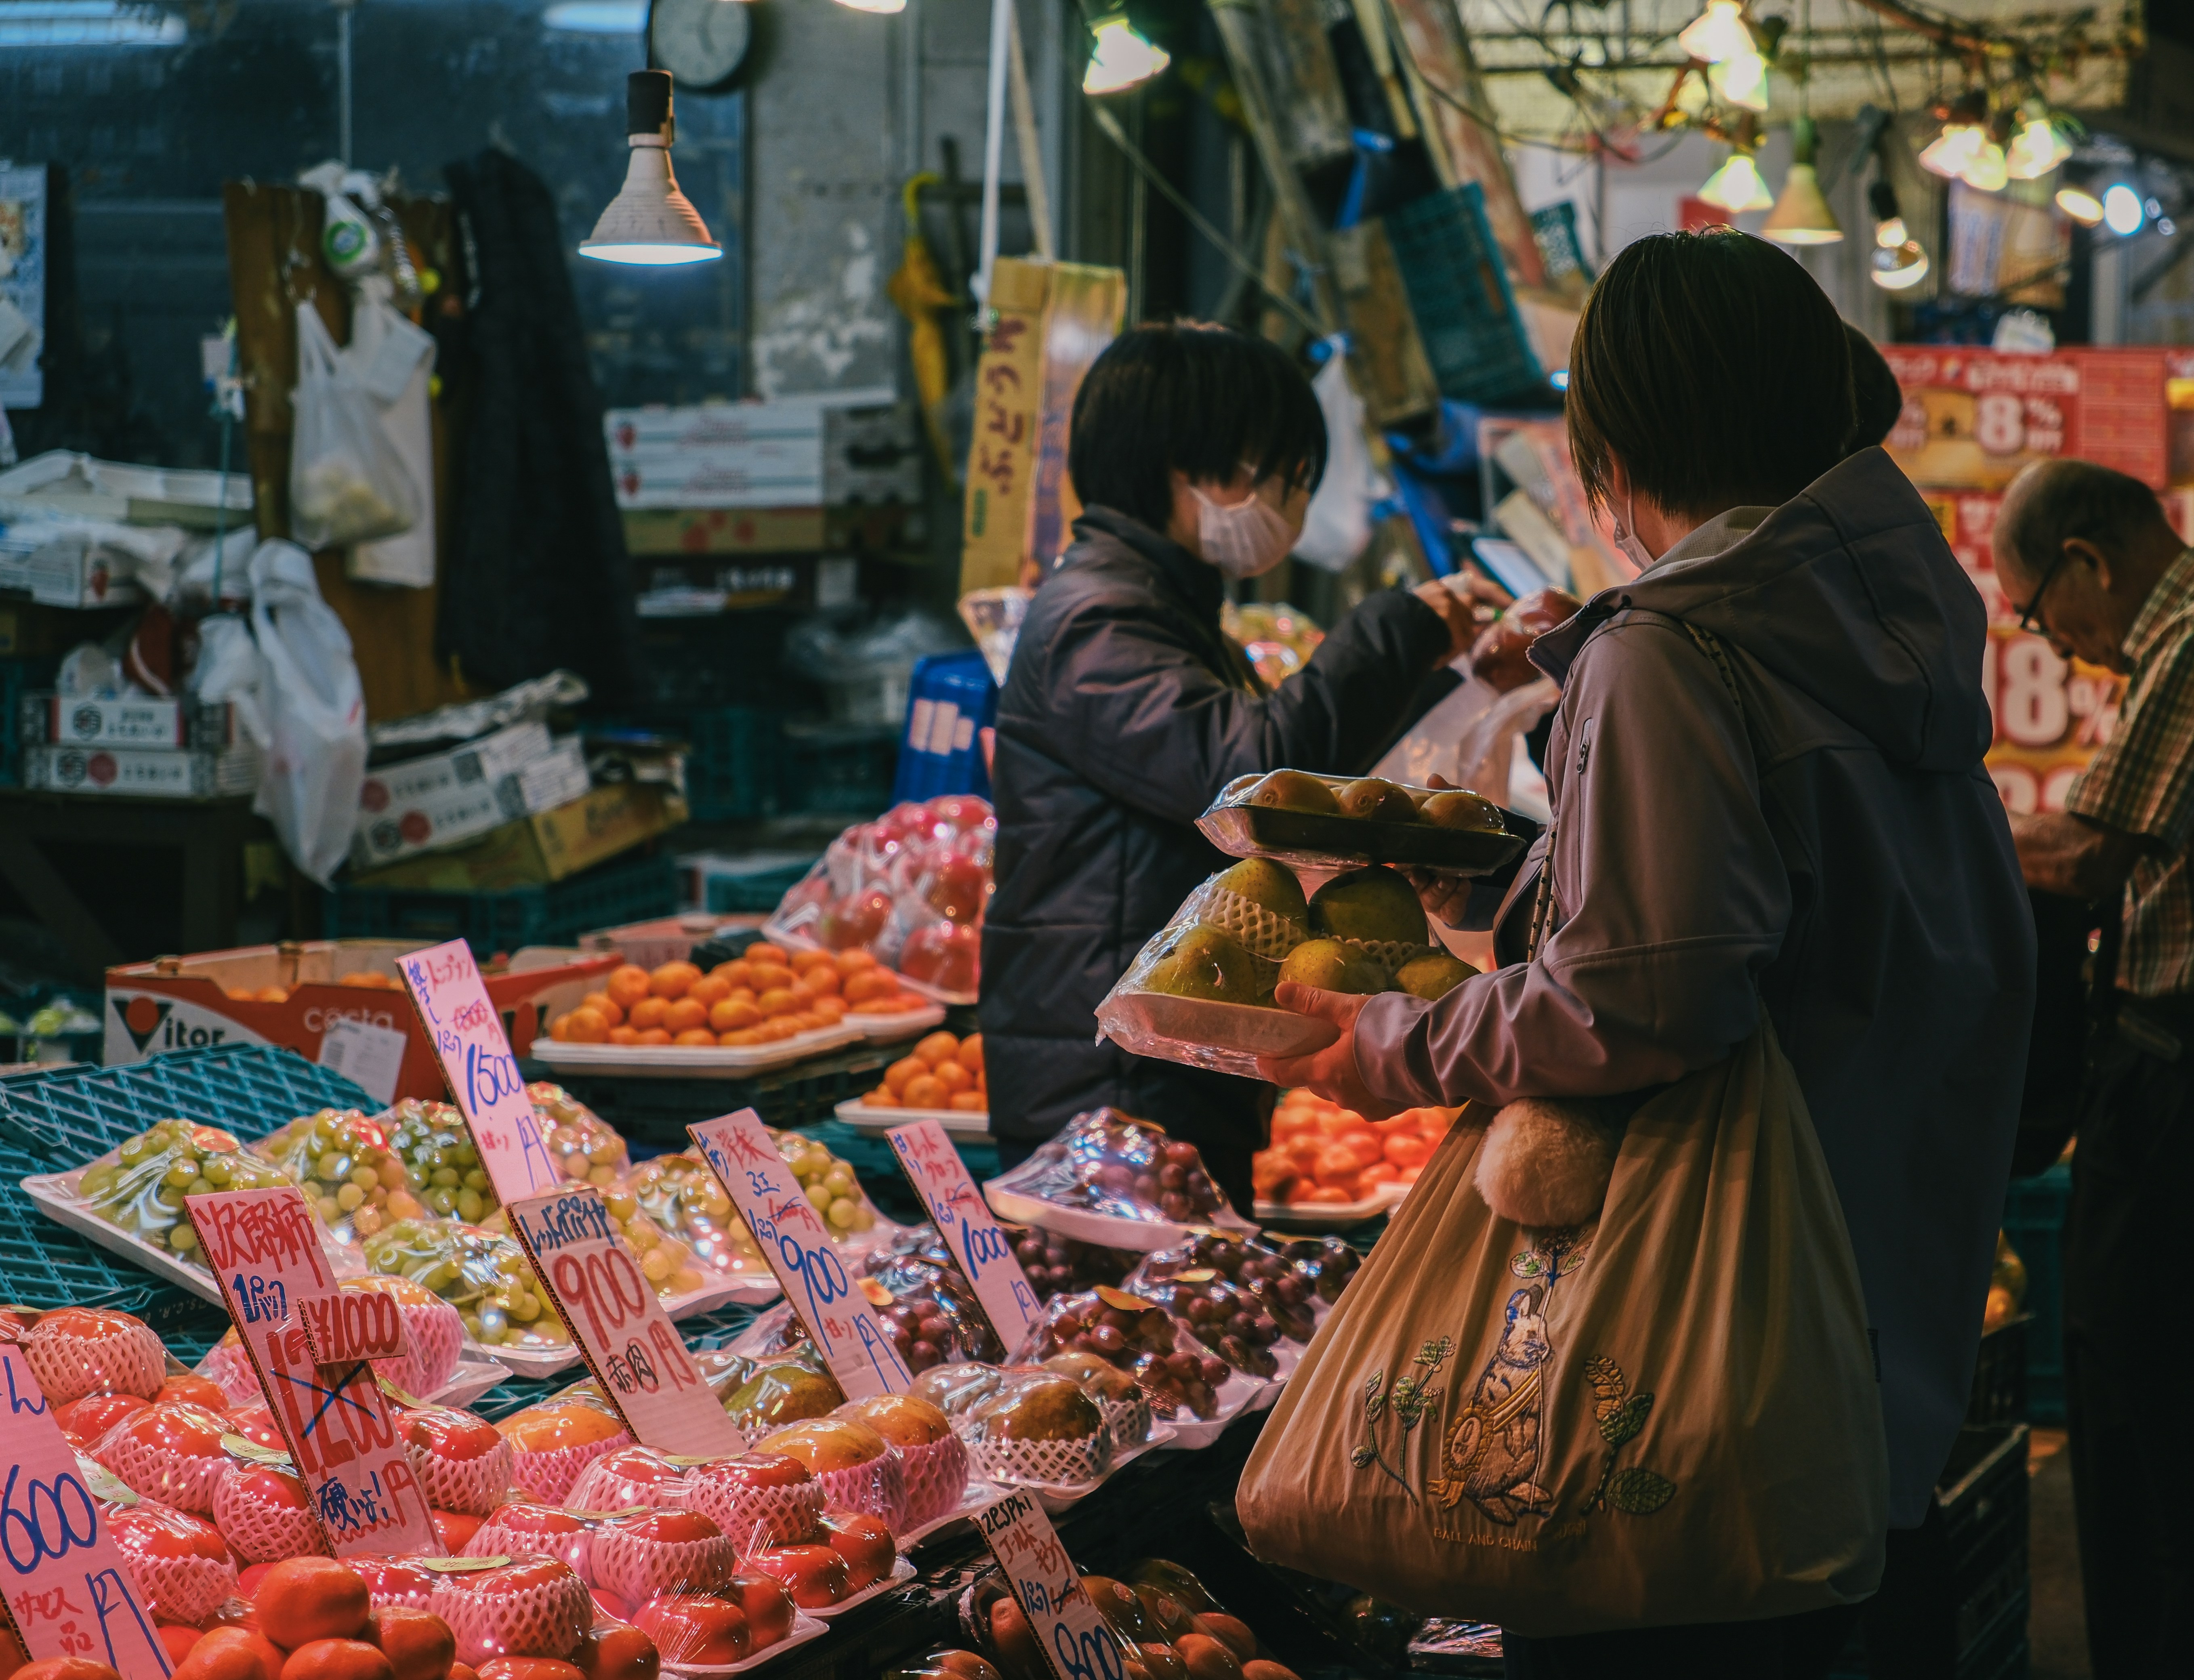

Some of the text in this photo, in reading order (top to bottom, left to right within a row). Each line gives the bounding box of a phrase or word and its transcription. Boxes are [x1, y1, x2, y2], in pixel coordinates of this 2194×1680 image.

[195, 1193, 324, 1289] 次郎柿
[308, 1292, 400, 1361] ¥1000
[552, 1248, 645, 1353] 900
[779, 1234, 848, 1359] 900
